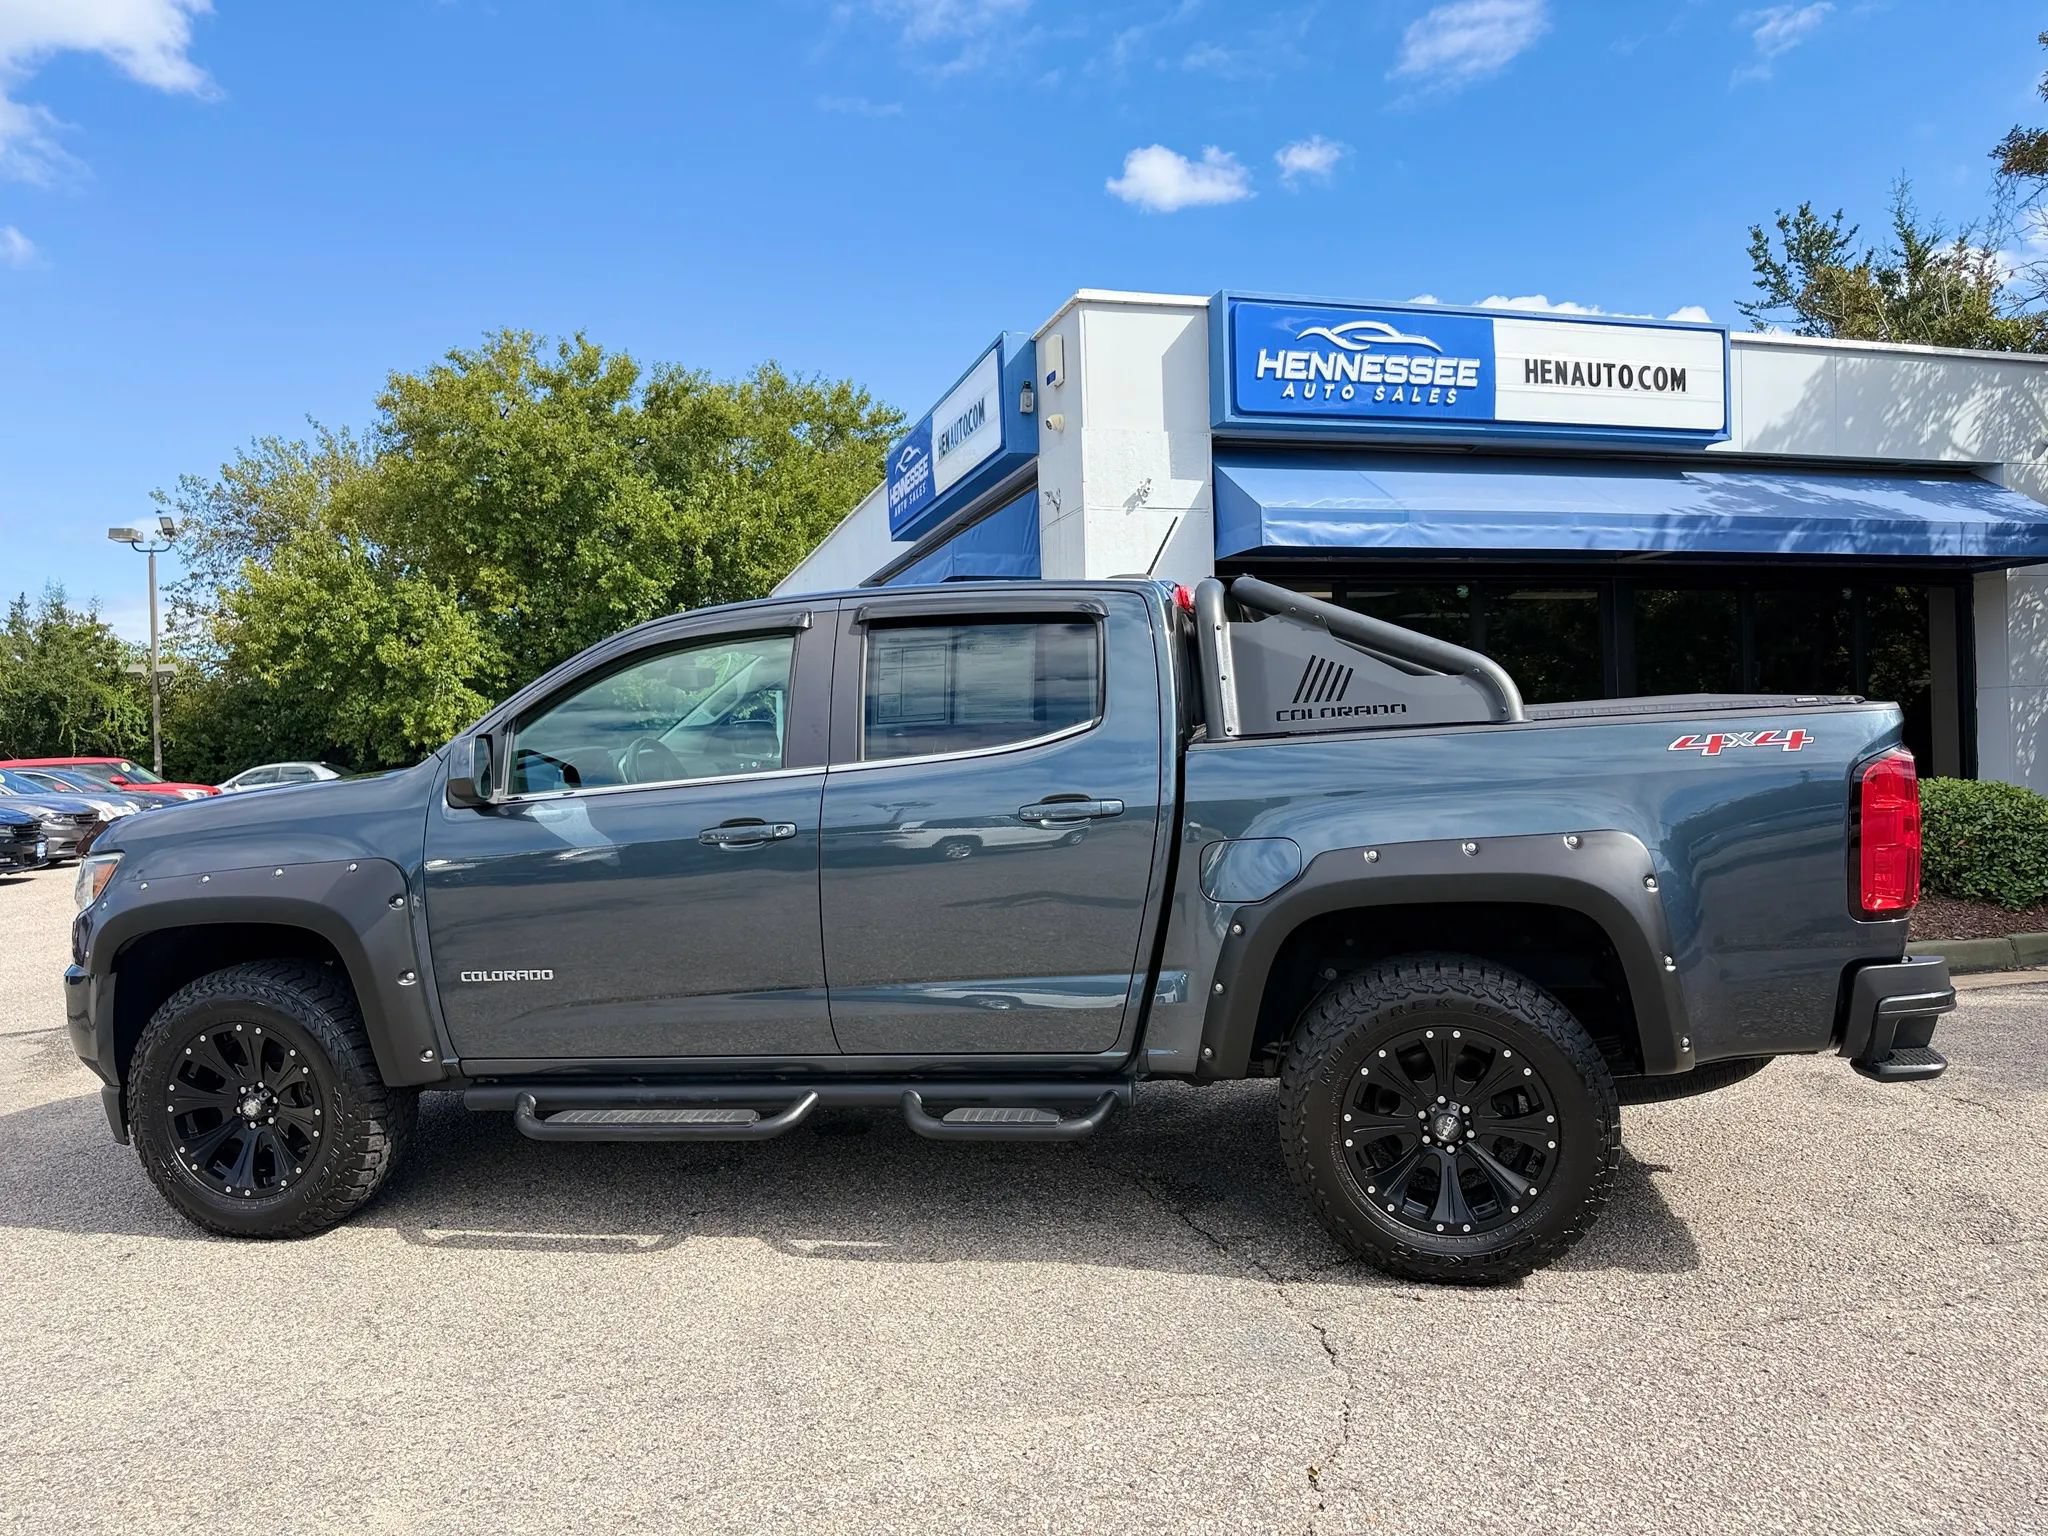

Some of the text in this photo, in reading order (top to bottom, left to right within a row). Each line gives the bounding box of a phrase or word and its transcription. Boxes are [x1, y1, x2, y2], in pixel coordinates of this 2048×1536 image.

[1256, 349, 1480, 387] HENNESSEE
[1282, 382, 1458, 405] AUTO SALES
[889, 452, 929, 508] HENNESSEE
[1276, 703, 1407, 721] COLORADO
[461, 969, 554, 982] COLORADO
